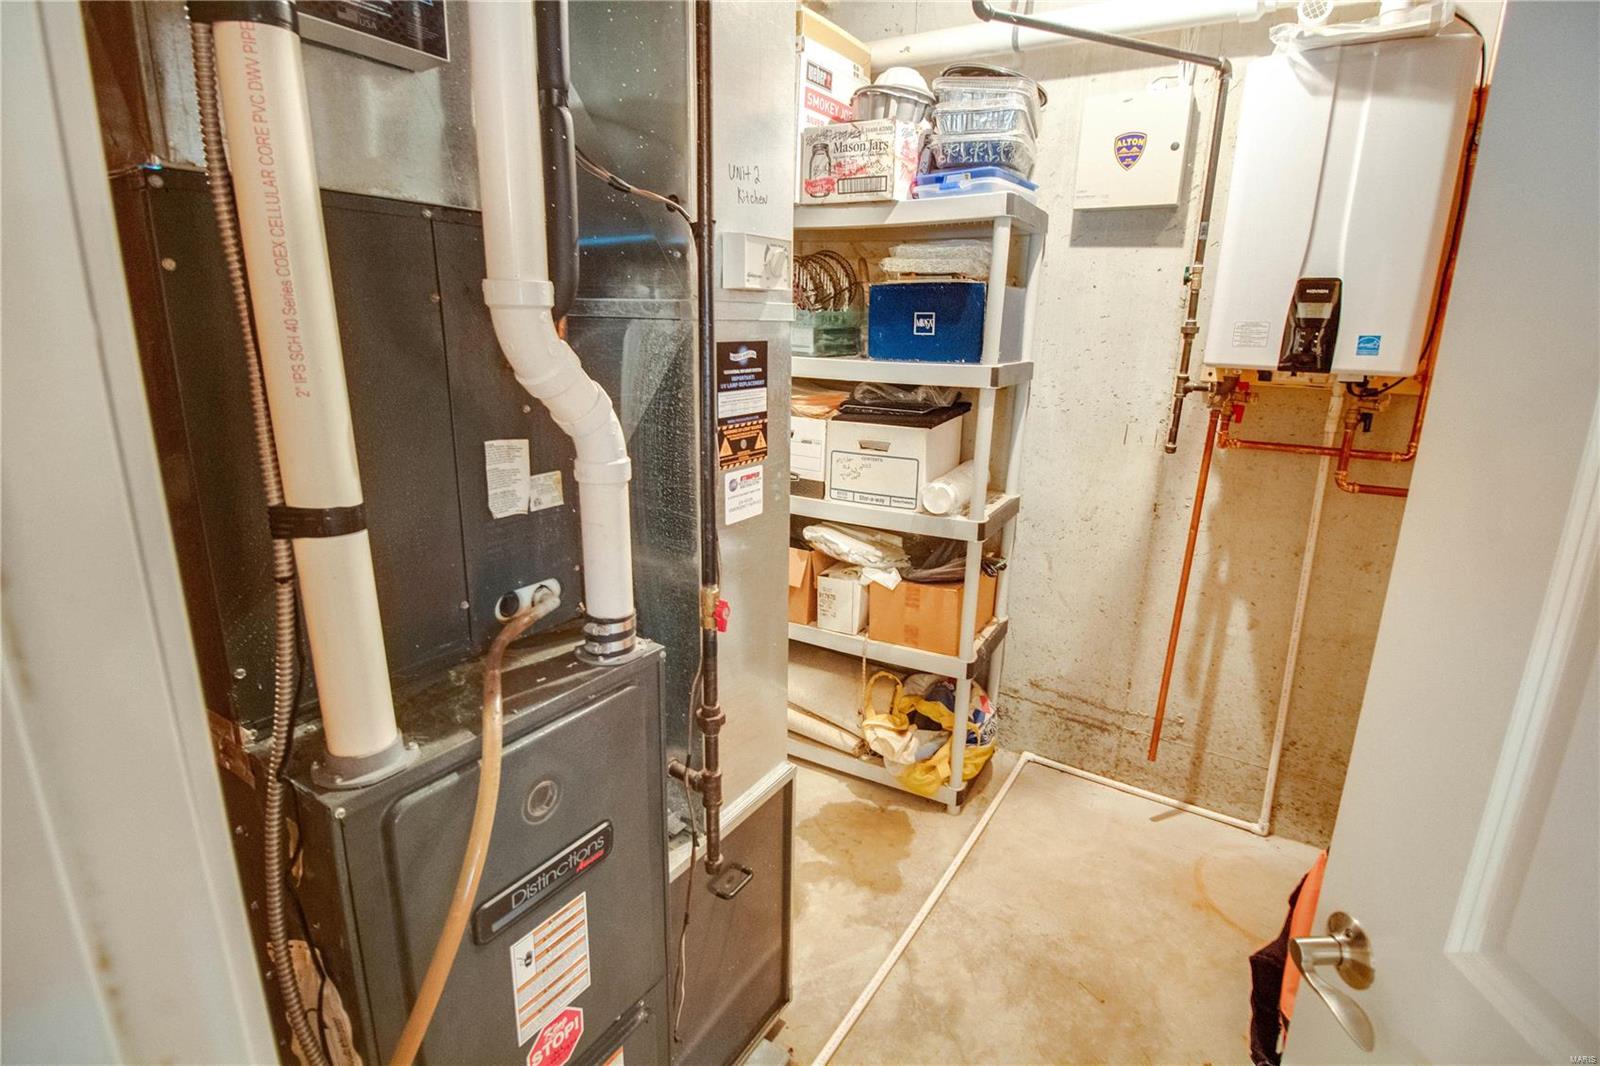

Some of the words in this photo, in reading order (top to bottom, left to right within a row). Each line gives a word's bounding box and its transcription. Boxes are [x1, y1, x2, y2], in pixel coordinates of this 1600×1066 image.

[240, 21, 258, 54] PIPE
[250, 95, 268, 123] PVC
[806, 92, 839, 116] SMOKEY
[253, 127, 275, 166] CORE
[833, 141, 866, 154] Mason
[869, 138, 889, 153] Jars
[1117, 137, 1145, 147] ALTON
[753, 165, 761, 184] 2
[260, 169, 285, 238] CELLULAR
[270, 240, 291, 277] COEX
[280, 279, 297, 316] Series
[284, 319, 299, 333] 40
[287, 336, 304, 361] SCH
[291, 363, 307, 384] IPS
[511, 836, 604, 909] Distinctions
[532, 1016, 579, 1066] STOP!
